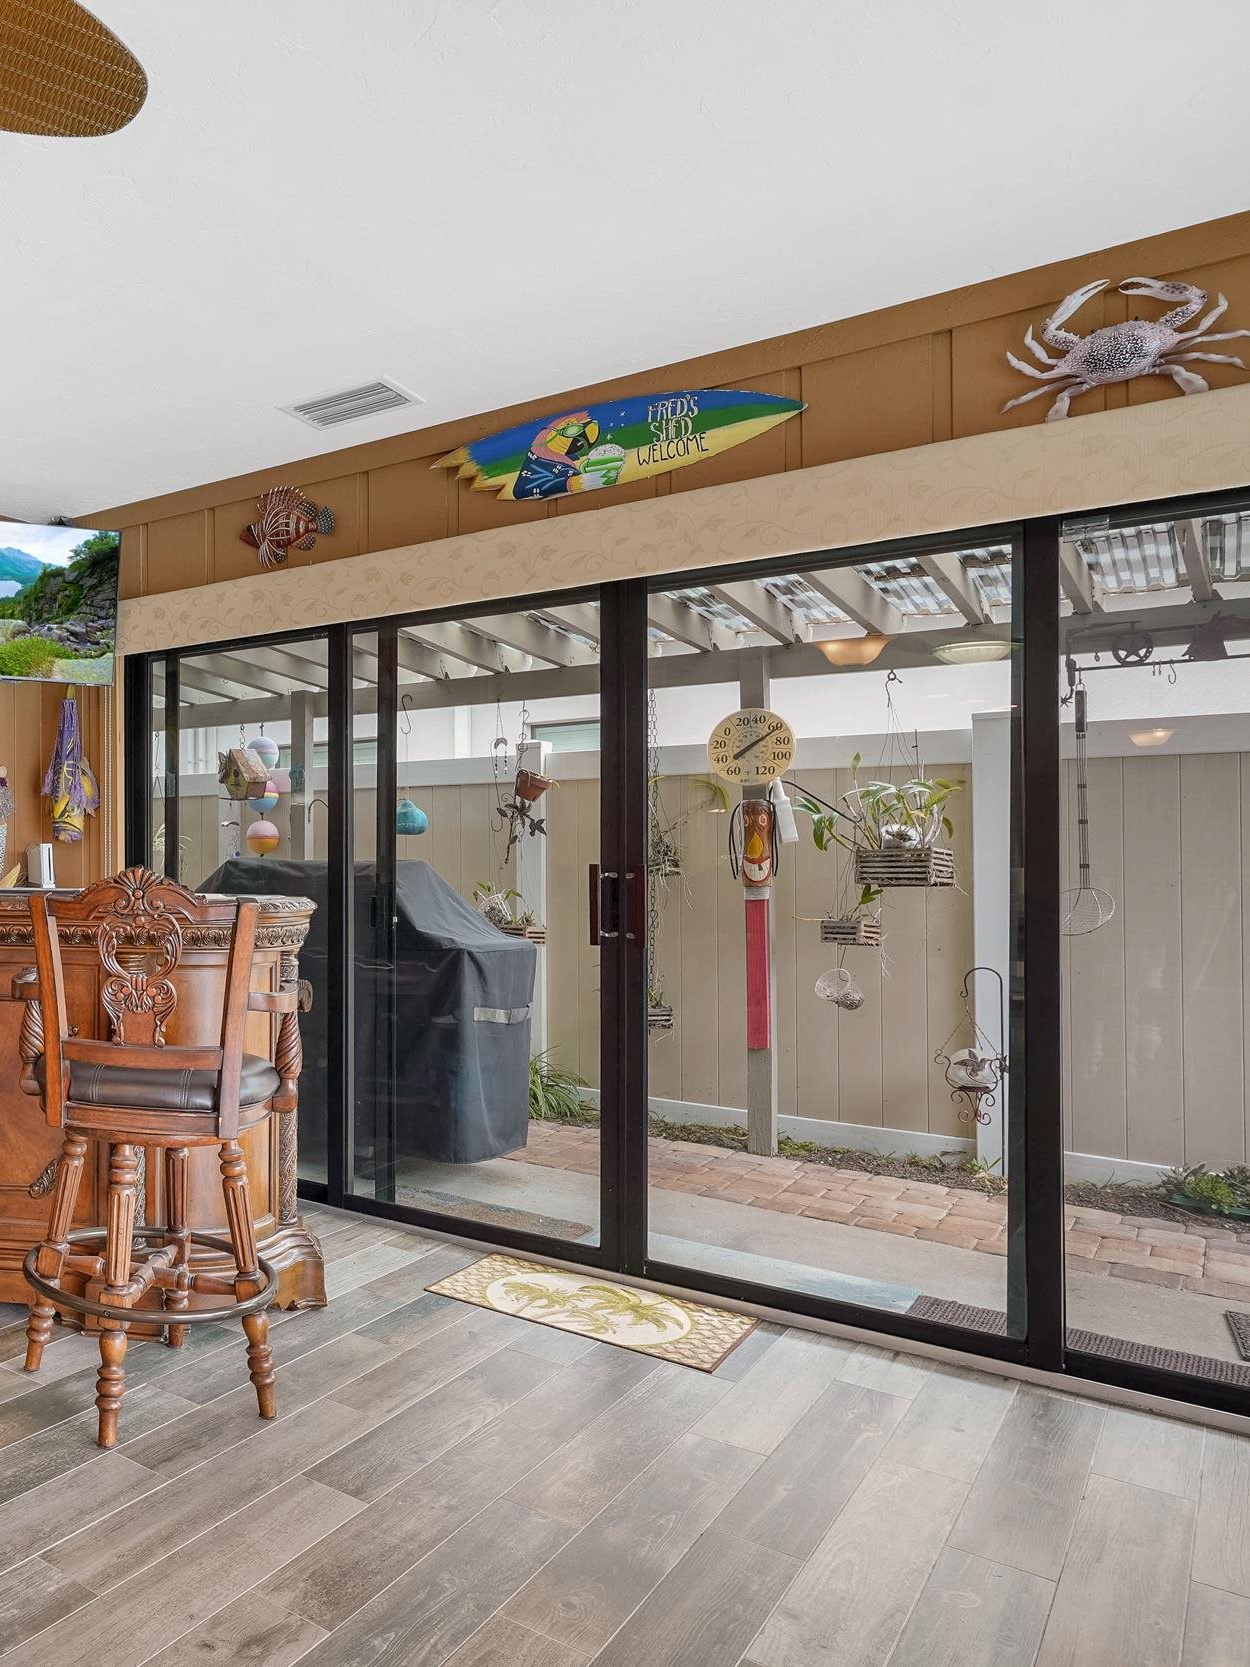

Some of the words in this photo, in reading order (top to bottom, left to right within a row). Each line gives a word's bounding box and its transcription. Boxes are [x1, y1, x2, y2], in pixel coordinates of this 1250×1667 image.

[648, 394, 699, 423] FRED'S
[650, 416, 692, 444] SHED
[637, 431, 709, 466] WELCOME
[736, 717, 750, 727] 20
[751, 714, 766, 725] 40
[724, 727, 731, 737] 0
[768, 721, 783, 732] 60
[775, 736, 790, 746] 80
[772, 751, 791, 761] 100
[755, 765, 775, 776] 120
